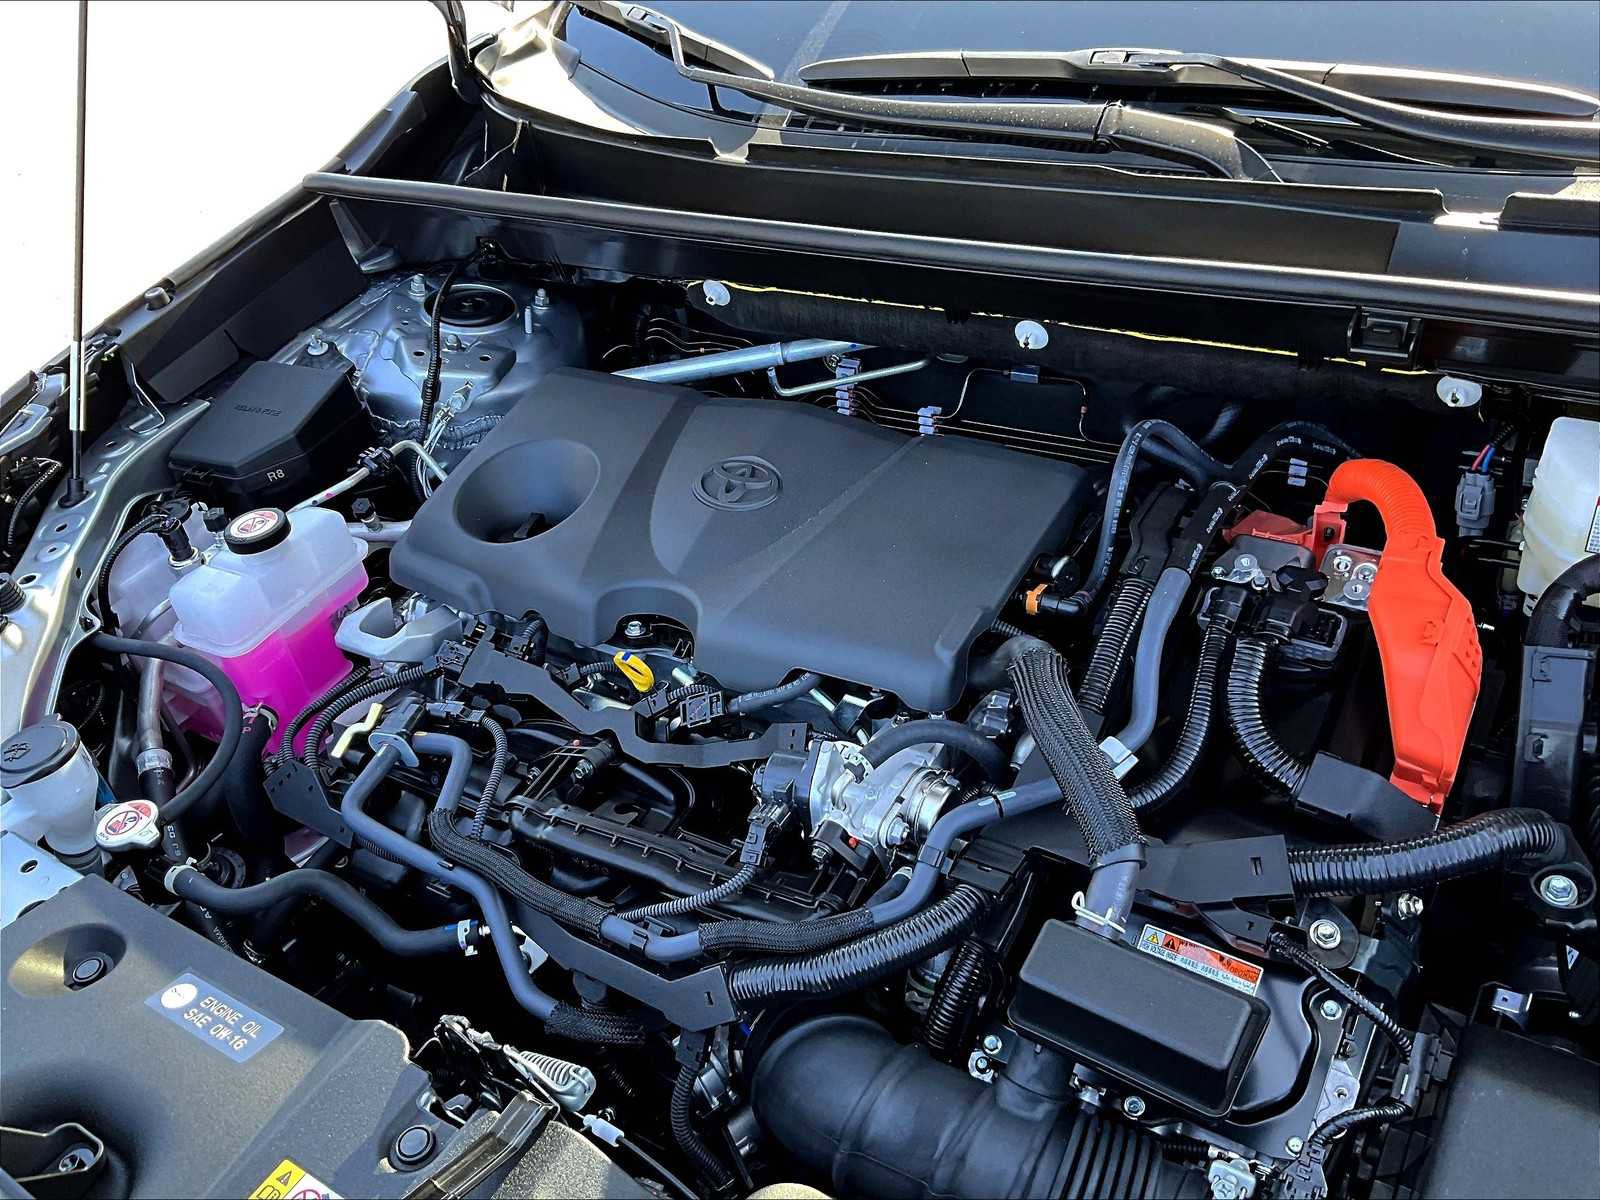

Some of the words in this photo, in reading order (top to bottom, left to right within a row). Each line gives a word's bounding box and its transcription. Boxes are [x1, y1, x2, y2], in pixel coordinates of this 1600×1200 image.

[266, 468, 285, 482] R8
[184, 1008, 212, 1029] SAE
[209, 1023, 248, 1051] 0W-16
[200, 996, 243, 1026] ENGINE
[241, 1020, 263, 1038] OIL
